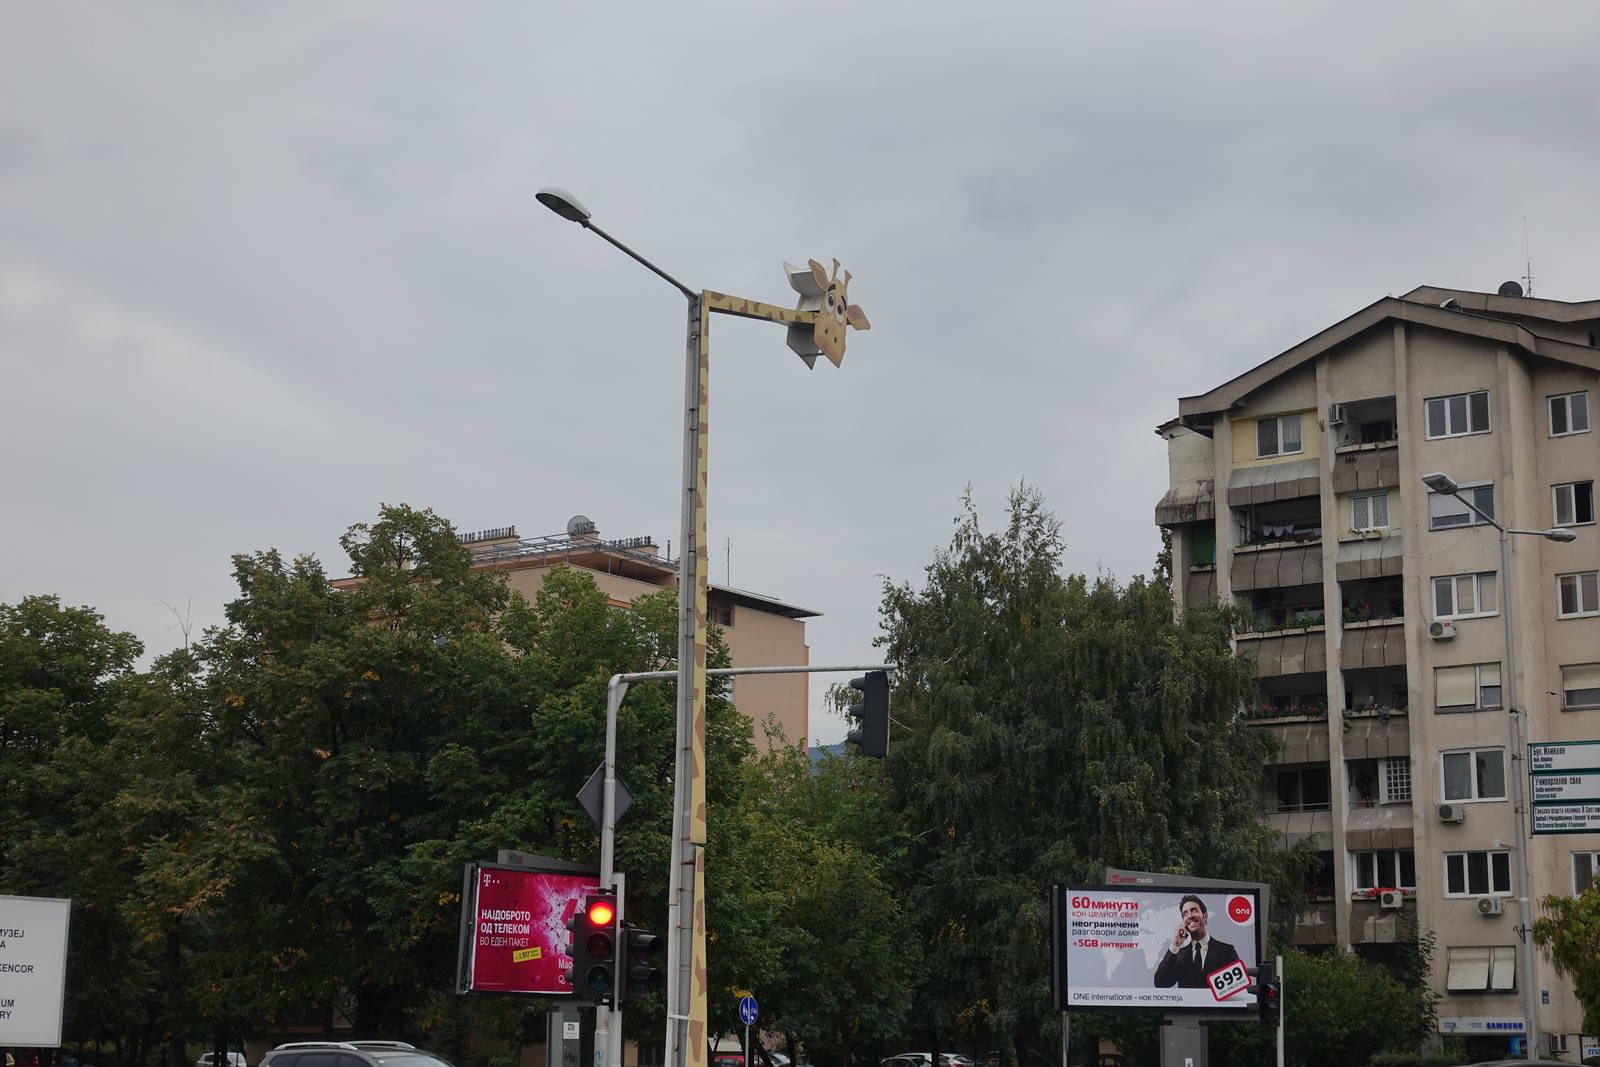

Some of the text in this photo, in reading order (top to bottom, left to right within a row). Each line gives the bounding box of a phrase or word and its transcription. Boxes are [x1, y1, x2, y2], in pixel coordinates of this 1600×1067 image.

[1072, 896, 1139, 912] 60 минути
[481, 909, 531, 921] НАЈДОБРОТО
[480, 922, 530, 934] ОД ТЕЛЕКОМ
[1072, 921, 1139, 929] неограничени
[1072, 929, 1116, 937] разговори
[479, 936, 529, 947] ВО ЕДЕН ПАКЕТ
[1073, 939, 1138, 949] +5GB интернет
[1214, 966, 1243, 990] 699
[1091, 993, 1133, 1001] International
[1486, 1022, 1523, 1030] SAMSUNG
